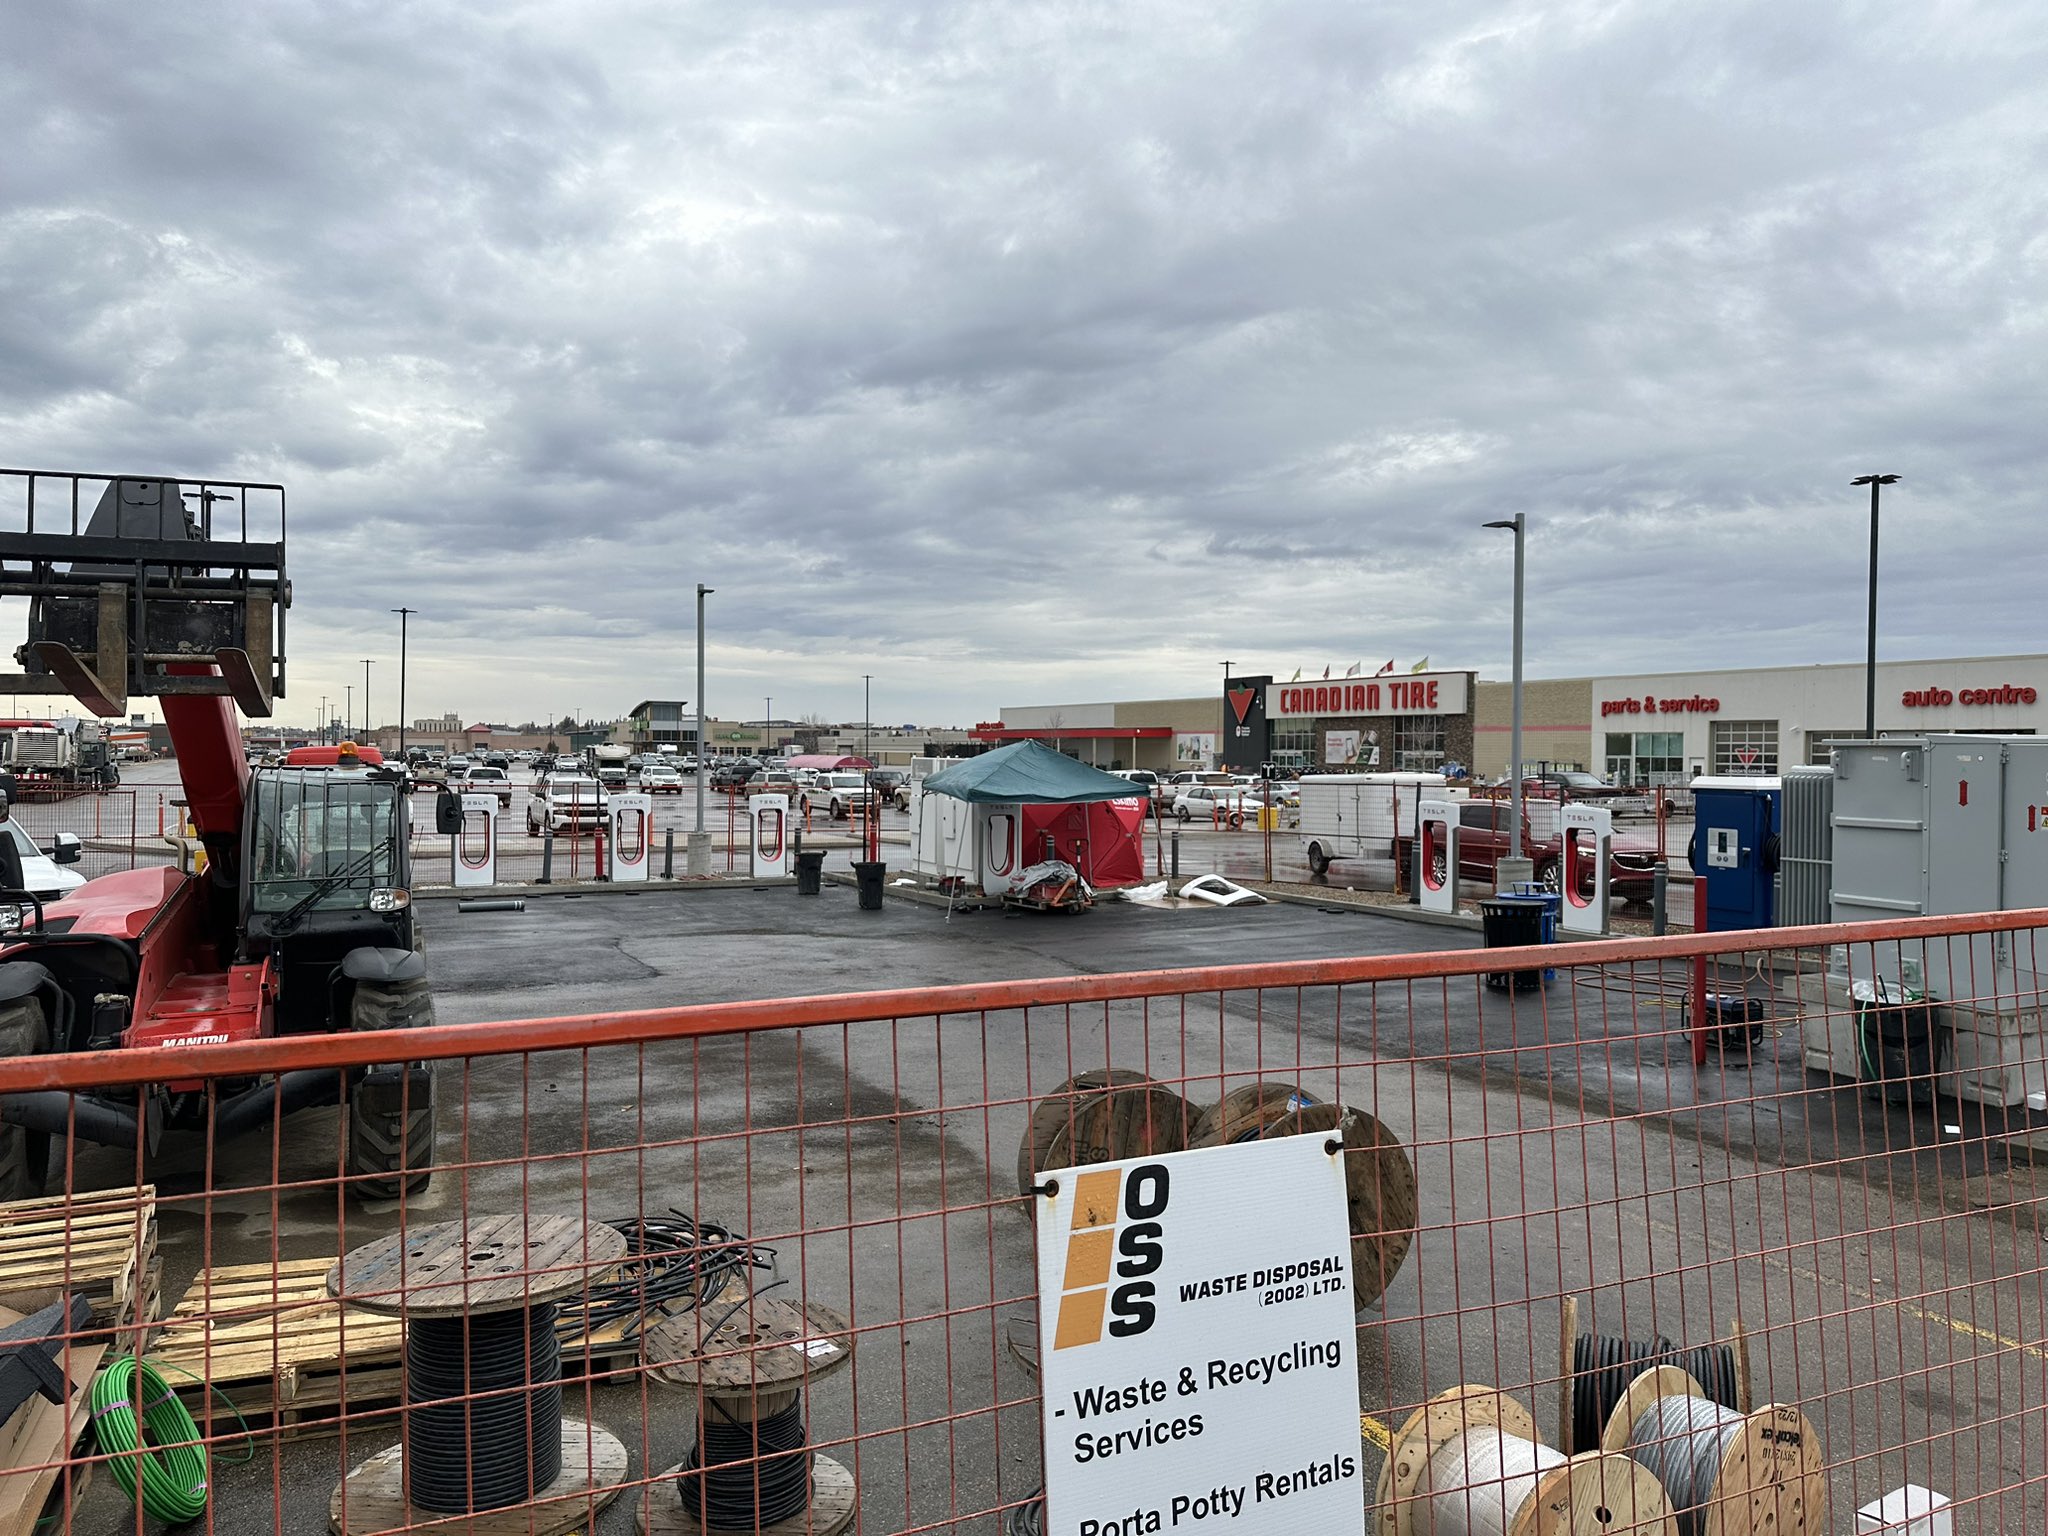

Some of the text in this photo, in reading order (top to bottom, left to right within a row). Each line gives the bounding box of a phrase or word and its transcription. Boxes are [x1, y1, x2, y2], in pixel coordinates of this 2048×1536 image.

[1280, 680, 1439, 713] CANADIAN TIRE
[1601, 695, 1720, 717] parts & service
[1902, 684, 2037, 707] auto centre
[1567, 814, 1595, 822] TESLA
[162, 1034, 229, 1048] MANITOU
[1180, 1256, 1344, 1303] WASTE DISPOSAL
[1257, 1277, 1346, 1308] (2002) LTD.
[1073, 1377, 1167, 1420] Waste
[1177, 1366, 1198, 1396] &
[1208, 1339, 1342, 1390] Recycling
[1073, 1413, 1205, 1464] Services
[1080, 1452, 1356, 1536] Porta Potty Rentals
